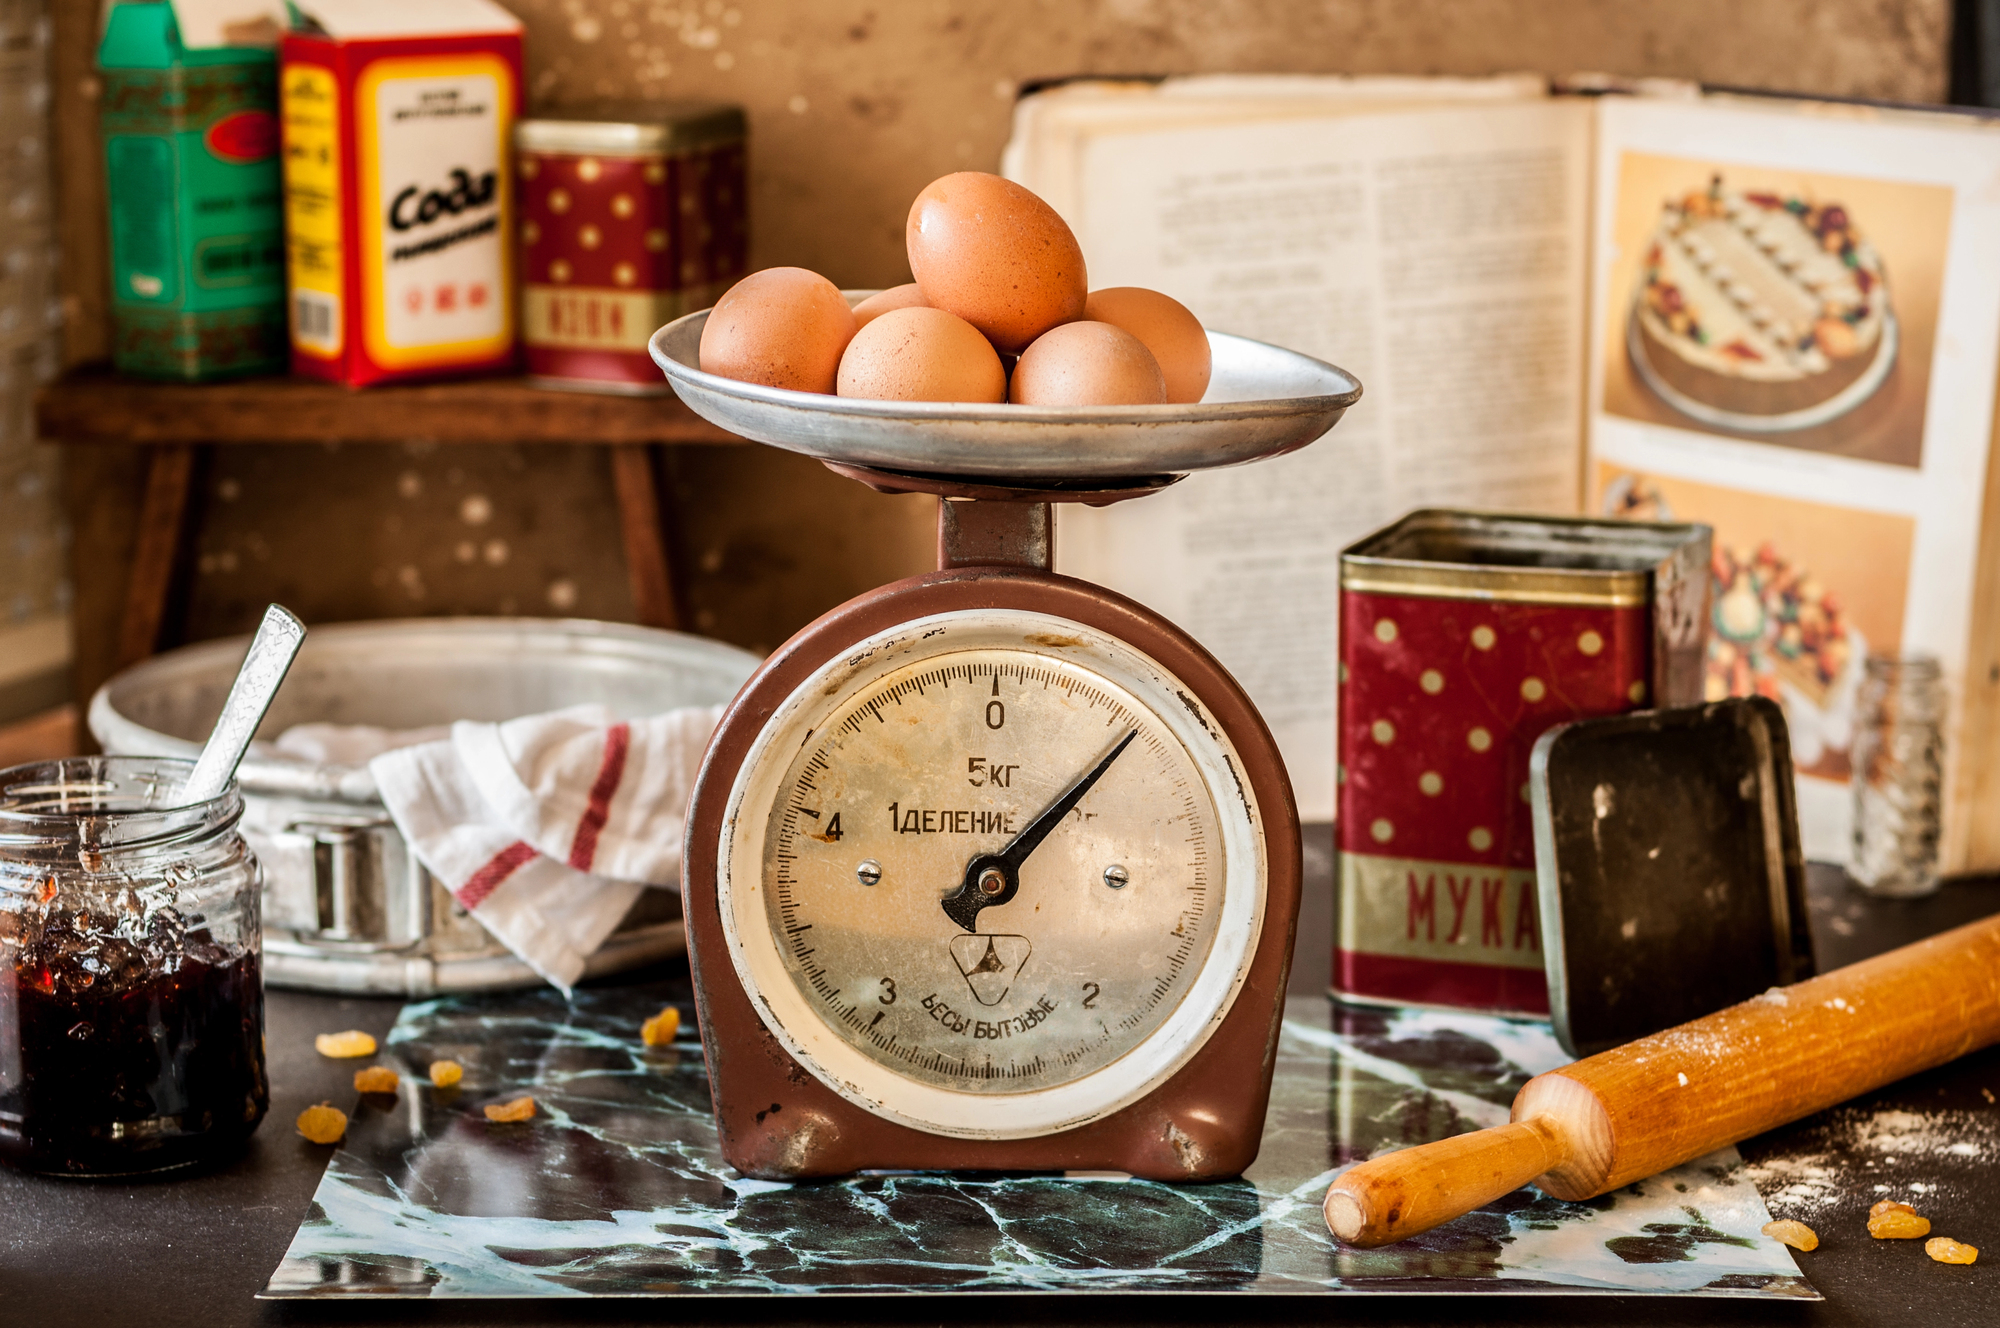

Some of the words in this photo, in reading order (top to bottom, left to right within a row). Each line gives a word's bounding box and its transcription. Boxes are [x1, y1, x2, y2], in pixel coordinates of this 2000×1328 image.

[389, 168, 496, 231] Сода
[986, 701, 1004, 729] 0
[826, 812, 843, 841] 4
[1407, 870, 1539, 952] МУКА
[878, 977, 897, 1005] 3
[1082, 982, 1100, 1009] 2
[974, 994, 1059, 1040] БЫТОВЫЕ
